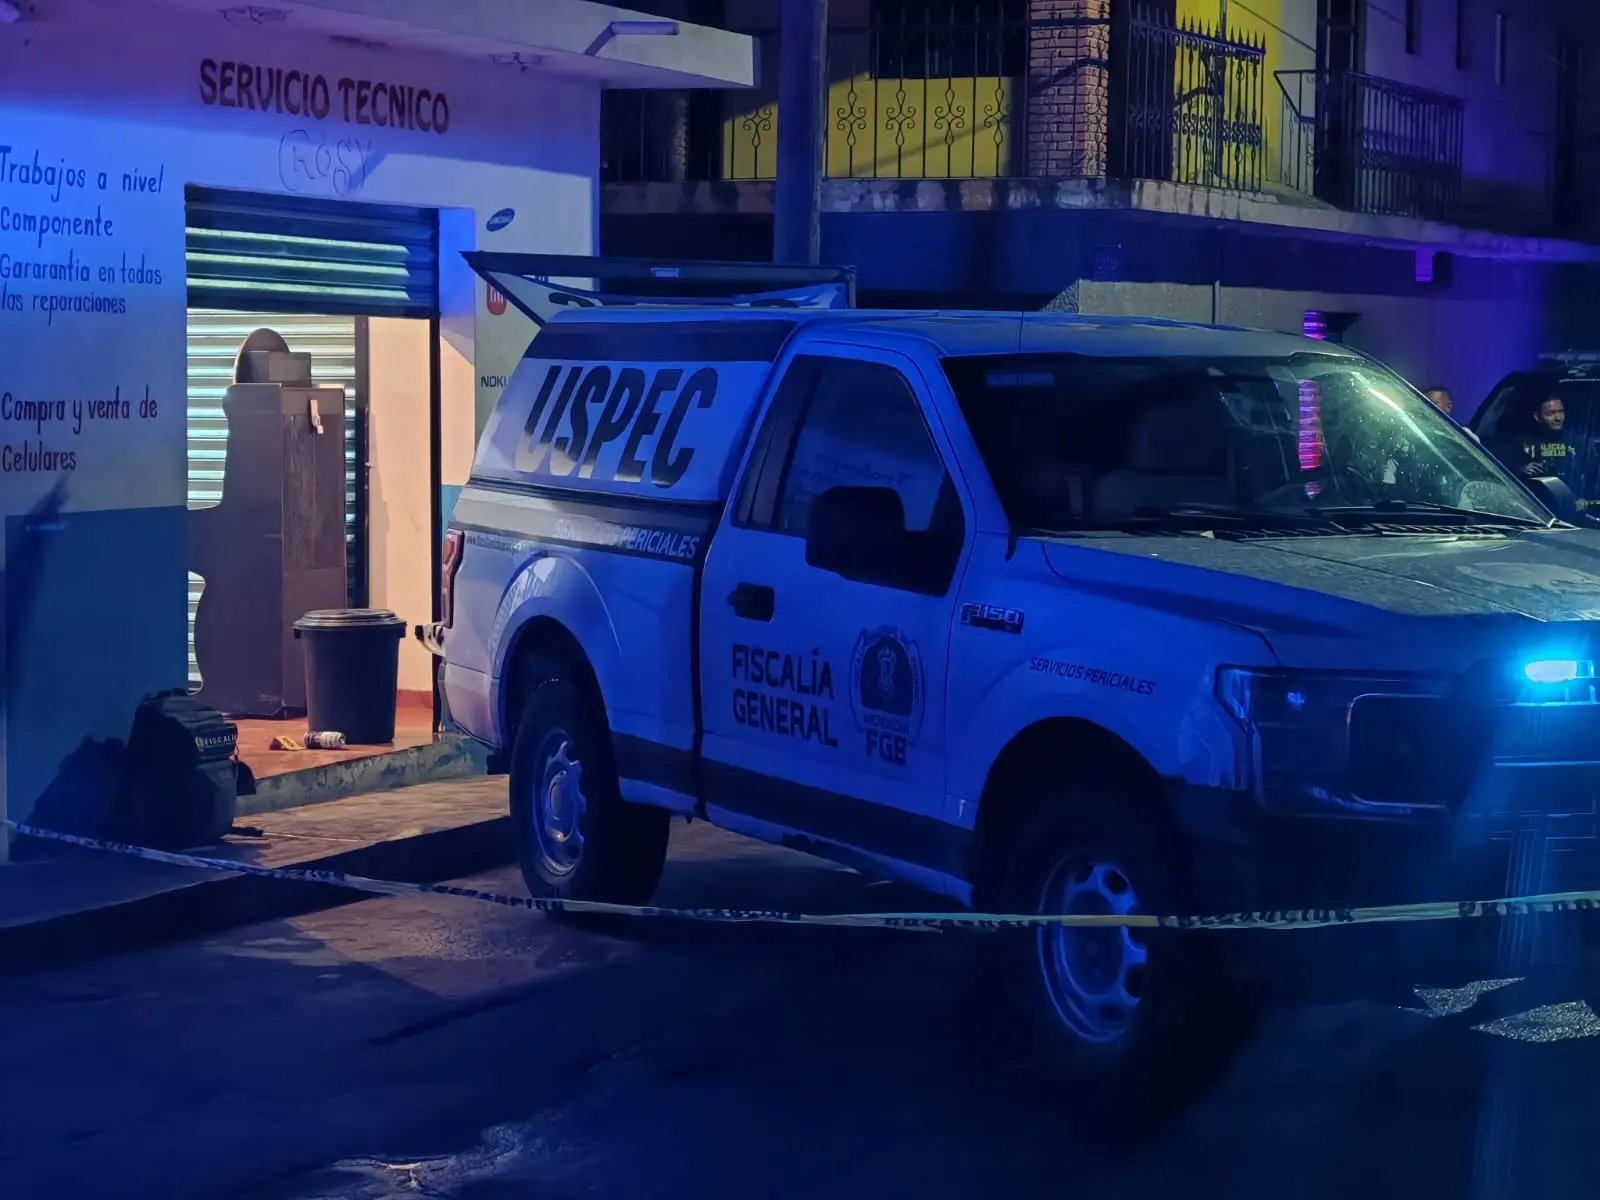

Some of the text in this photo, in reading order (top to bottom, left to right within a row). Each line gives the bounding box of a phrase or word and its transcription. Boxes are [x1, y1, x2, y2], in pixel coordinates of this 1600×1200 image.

[200, 58, 449, 135] SERVICIO TECNICO
[0, 145, 164, 203] Trabajos a nivel
[0, 205, 113, 248] Componente
[98, 266, 115, 284] en
[121, 250, 162, 285] todas
[1, 281, 126, 327] las reparaciones
[480, 375, 507, 388] NOKI
[2, 384, 158, 435] Compra y venta de
[515, 364, 719, 489] USPEC
[2, 440, 76, 472] Celulares
[619, 526, 700, 559] PERICIALES
[732, 643, 835, 700] FISCALÍA
[1029, 655, 1156, 696] SERVICIOS PERICIALES
[732, 688, 839, 749] GENERAL
